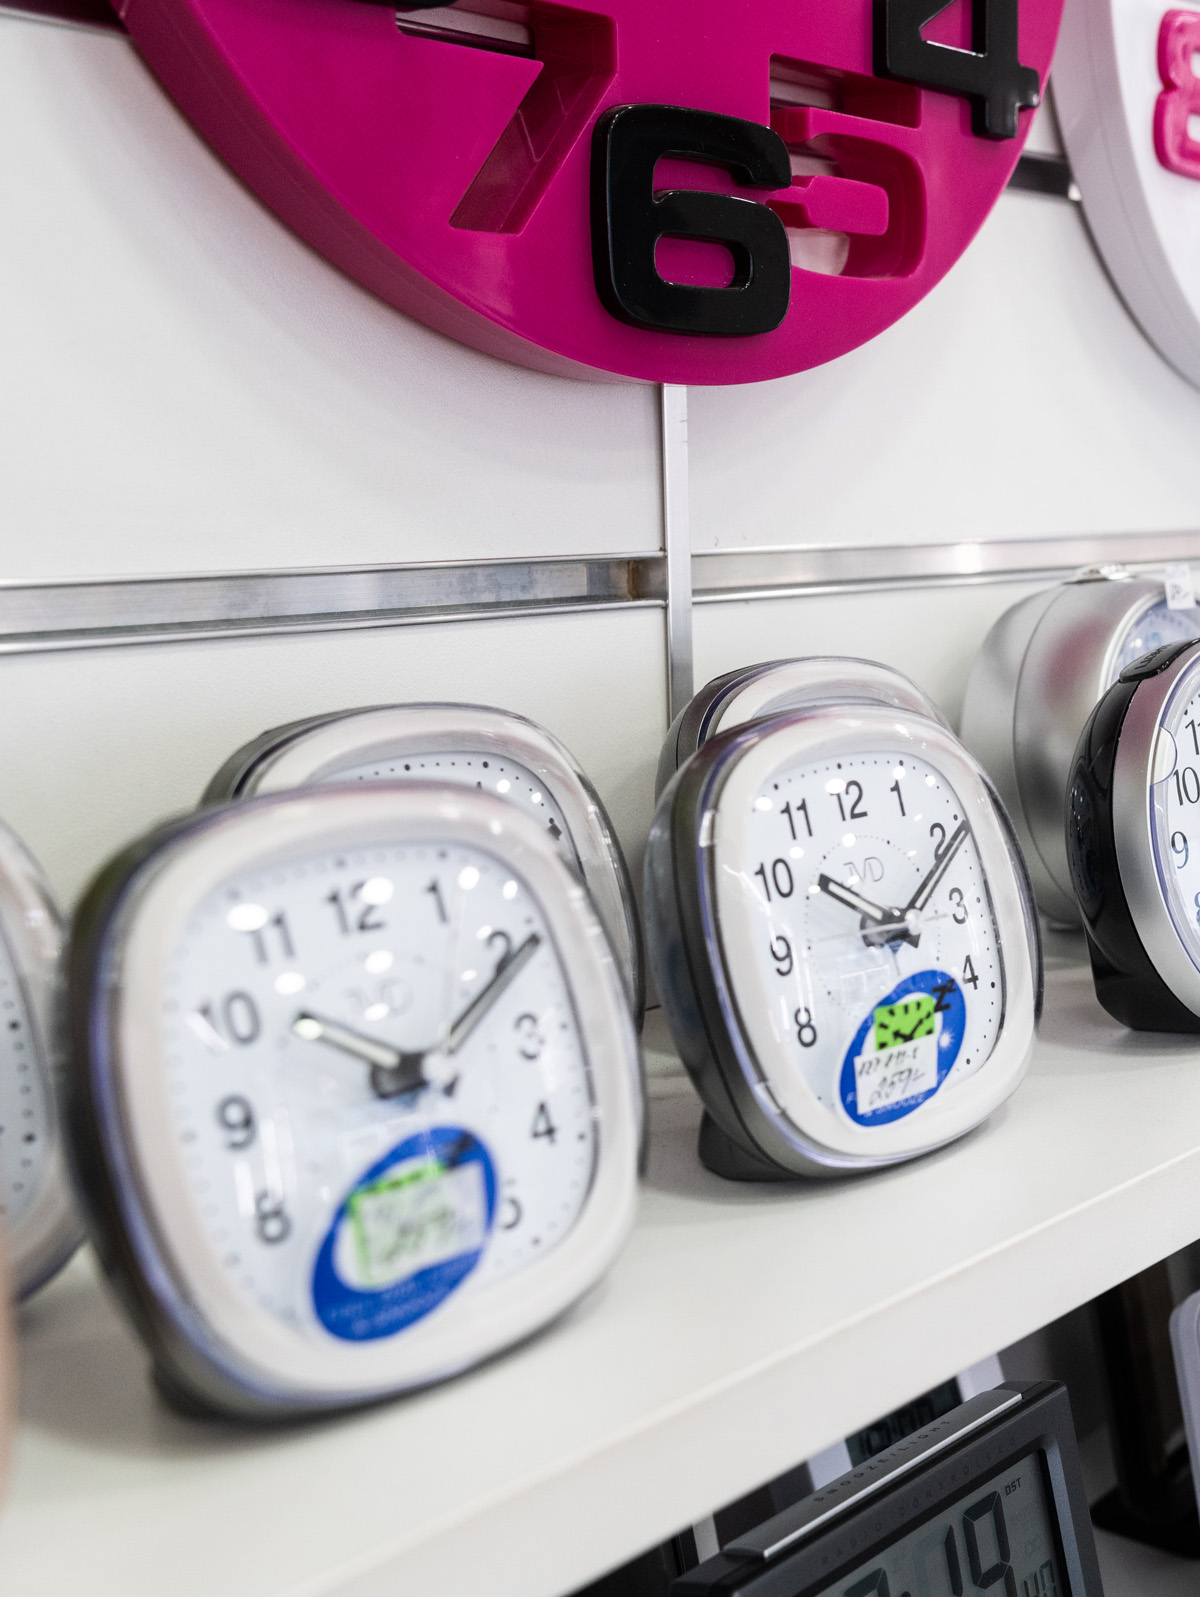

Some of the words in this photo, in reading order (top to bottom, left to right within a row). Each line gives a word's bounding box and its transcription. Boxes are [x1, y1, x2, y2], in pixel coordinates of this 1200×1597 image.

[873, 0, 1039, 139] 4
[590, 103, 793, 337] 6
[833, 780, 868, 822] 12
[890, 780, 907, 818] 1
[1172, 766, 1200, 806] 10
[780, 797, 814, 841] 11
[1171, 831, 1189, 869] 9
[423, 877, 449, 924] 1
[755, 858, 794, 901] 10
[327, 882, 387, 936] 12
[949, 887, 969, 924] 3
[250, 911, 297, 966] 11
[770, 936, 795, 978] 9
[961, 954, 980, 992] 4
[199, 990, 260, 1047] 10
[515, 1011, 548, 1062] 3
[794, 1006, 818, 1049] 8
[216, 1095, 257, 1152] 9
[530, 1102, 560, 1146] 4
[254, 1188, 293, 1246] 8
[1004, 1477, 1022, 1497] DST
